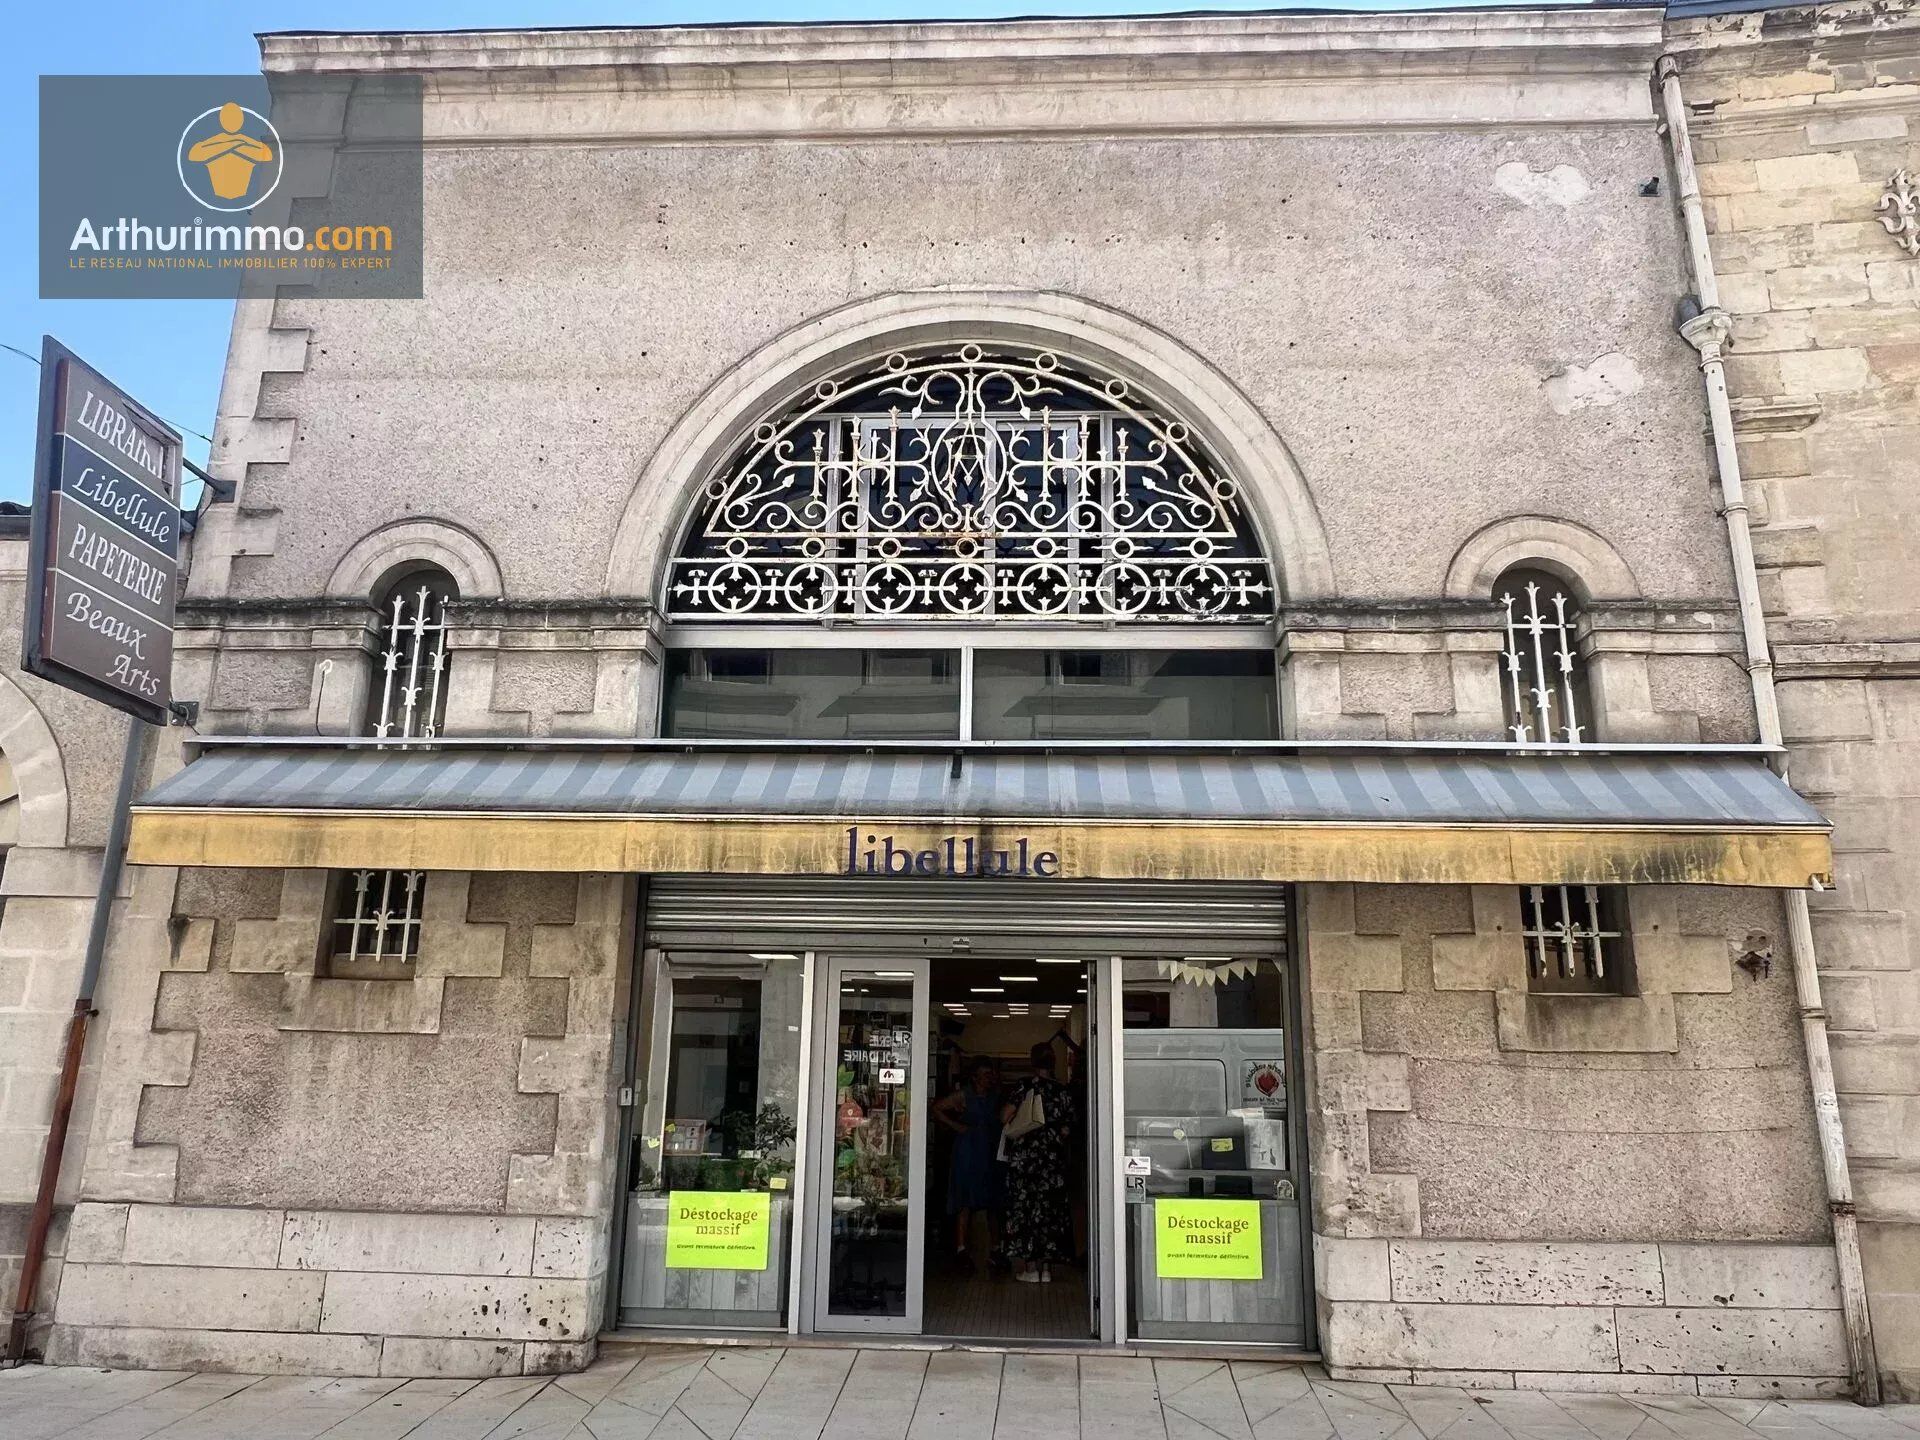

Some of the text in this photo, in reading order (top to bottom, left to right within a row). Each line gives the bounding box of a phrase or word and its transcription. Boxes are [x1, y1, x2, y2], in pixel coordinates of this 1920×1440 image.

[71, 467, 170, 543] Libellule
[68, 523, 168, 606] PAPETERIE
[66, 592, 147, 660] Beaux
[105, 654, 161, 696] Arts
[845, 826, 1059, 877] libellule
[1126, 1176, 1144, 1189] LR
[680, 1207, 758, 1225] Déstockage
[696, 1223, 741, 1235] massif
[1167, 1216, 1249, 1233] Déstockage
[1185, 1231, 1232, 1244] massif
